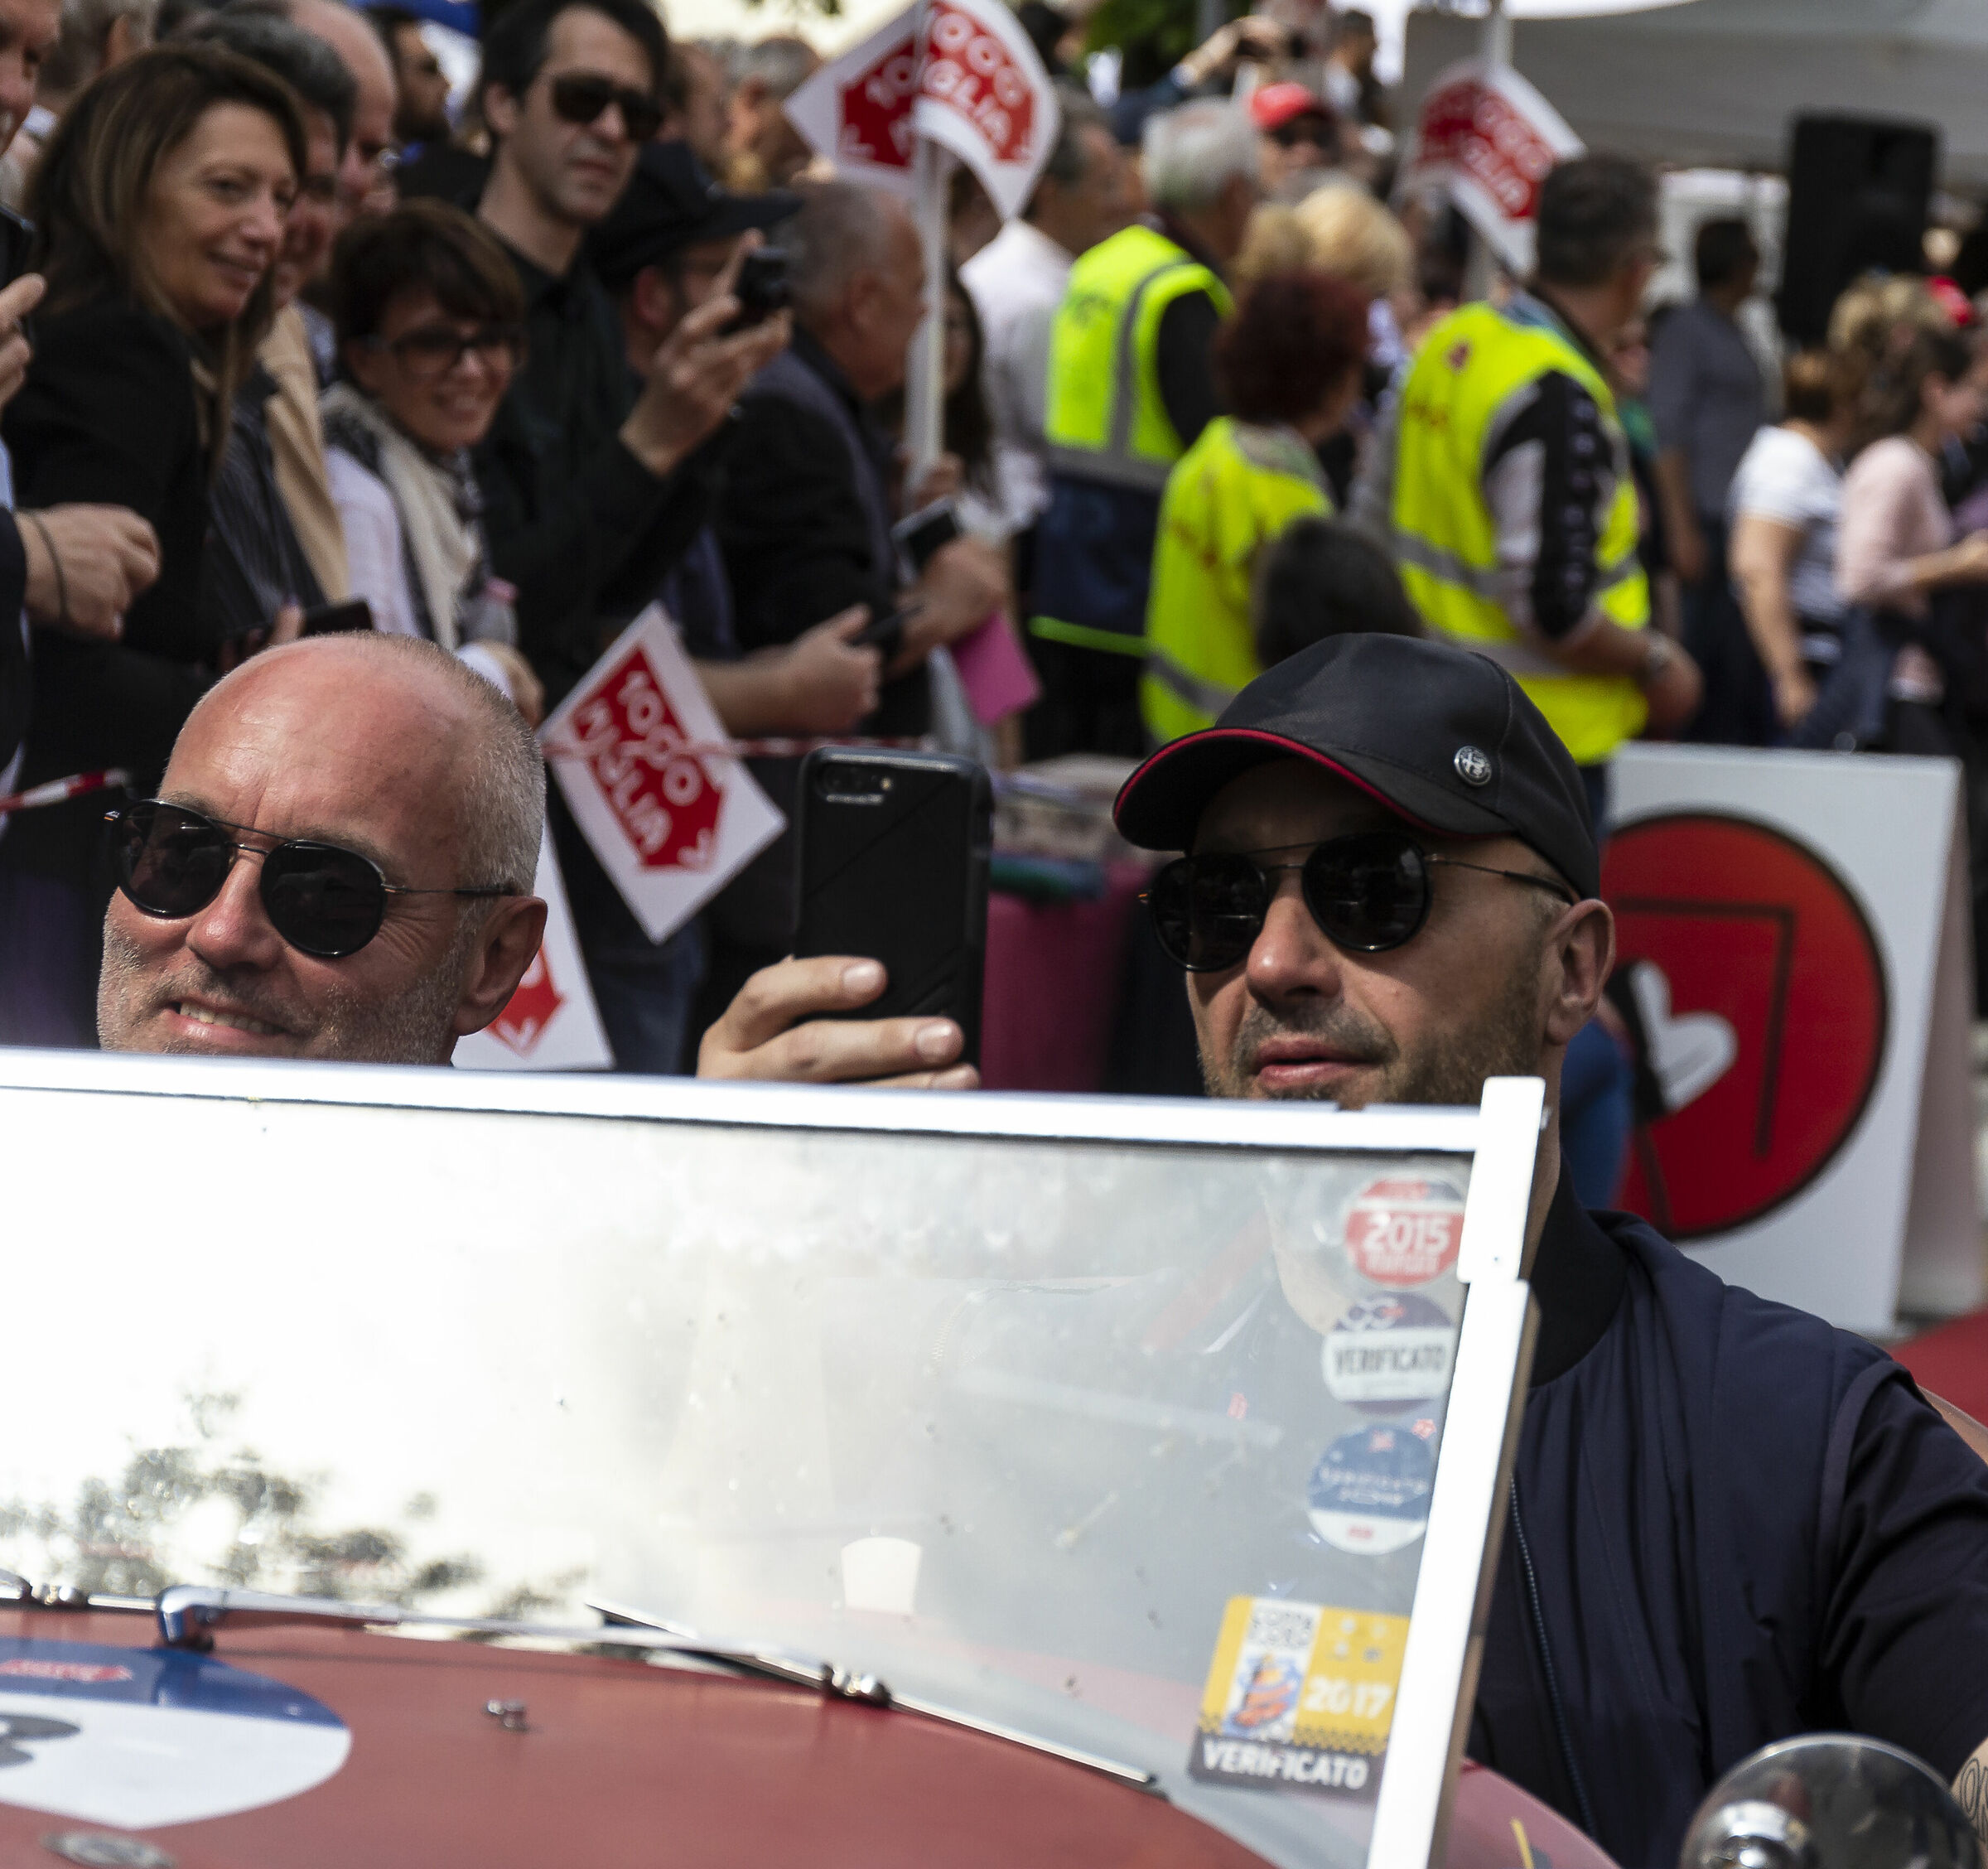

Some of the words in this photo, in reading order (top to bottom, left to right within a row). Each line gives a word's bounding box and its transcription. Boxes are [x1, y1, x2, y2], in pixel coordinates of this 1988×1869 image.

[617, 669, 704, 807] 1000
[1363, 1213, 1449, 1254] 2015
[1304, 1674, 1393, 1720] 2017
[1203, 1739, 1369, 1790] VERIFICATO
